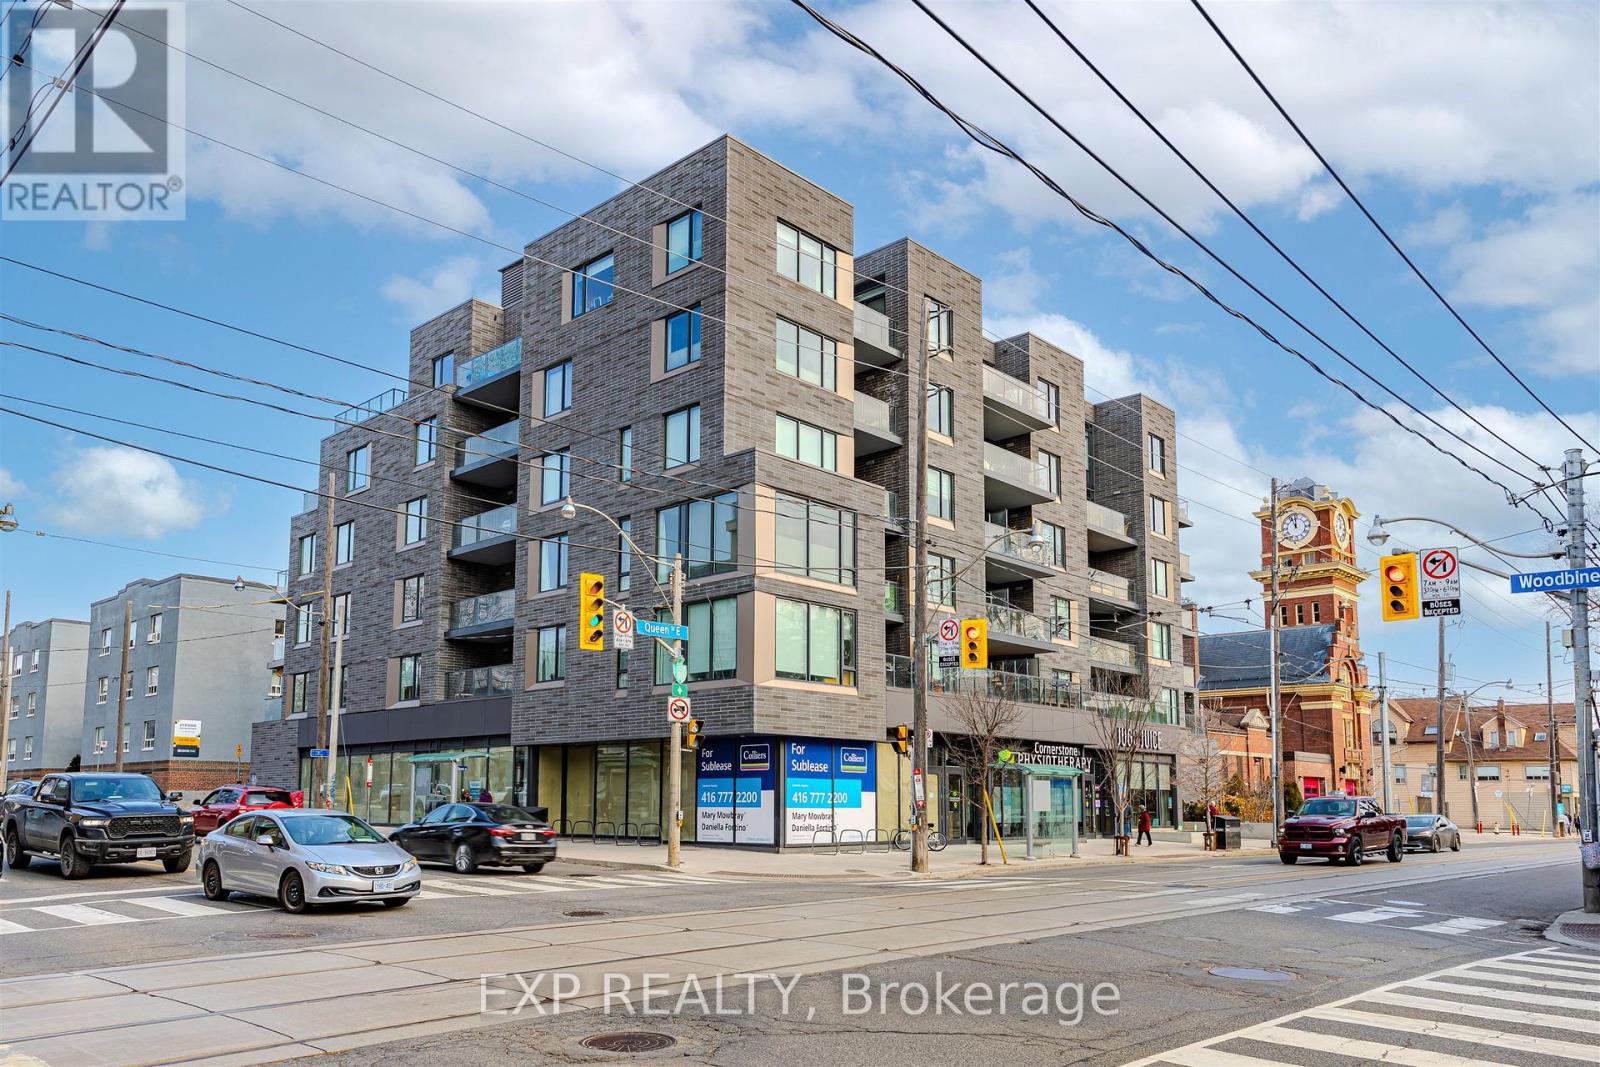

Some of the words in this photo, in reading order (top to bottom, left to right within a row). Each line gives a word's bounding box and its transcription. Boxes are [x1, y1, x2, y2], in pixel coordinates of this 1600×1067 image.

[1519, 570, 1600, 589] Woodbine
[644, 622, 670, 635] Queen
[676, 626, 681, 636] E
[1140, 730, 1162, 750] JUICE
[701, 748, 713, 758] For
[743, 750, 767, 760] Colliers
[792, 743, 806, 755] For
[1034, 741, 1079, 757] Cornerstone
[843, 752, 865, 763] Colliers
[1018, 752, 1093, 770] PHYSIOTHERAPY
[701, 761, 732, 771] Sublease
[792, 759, 829, 772] Sublease
[701, 791, 716, 803] 416
[717, 791, 734, 803] 777
[736, 791, 758, 803] 2200
[792, 791, 808, 804] 416
[809, 792, 826, 804] 777
[827, 792, 848, 804] 2200
[702, 811, 716, 820] Mary
[792, 812, 807, 822] Mary
[702, 823, 724, 831] Daniella
[792, 824, 815, 832] Daniella
